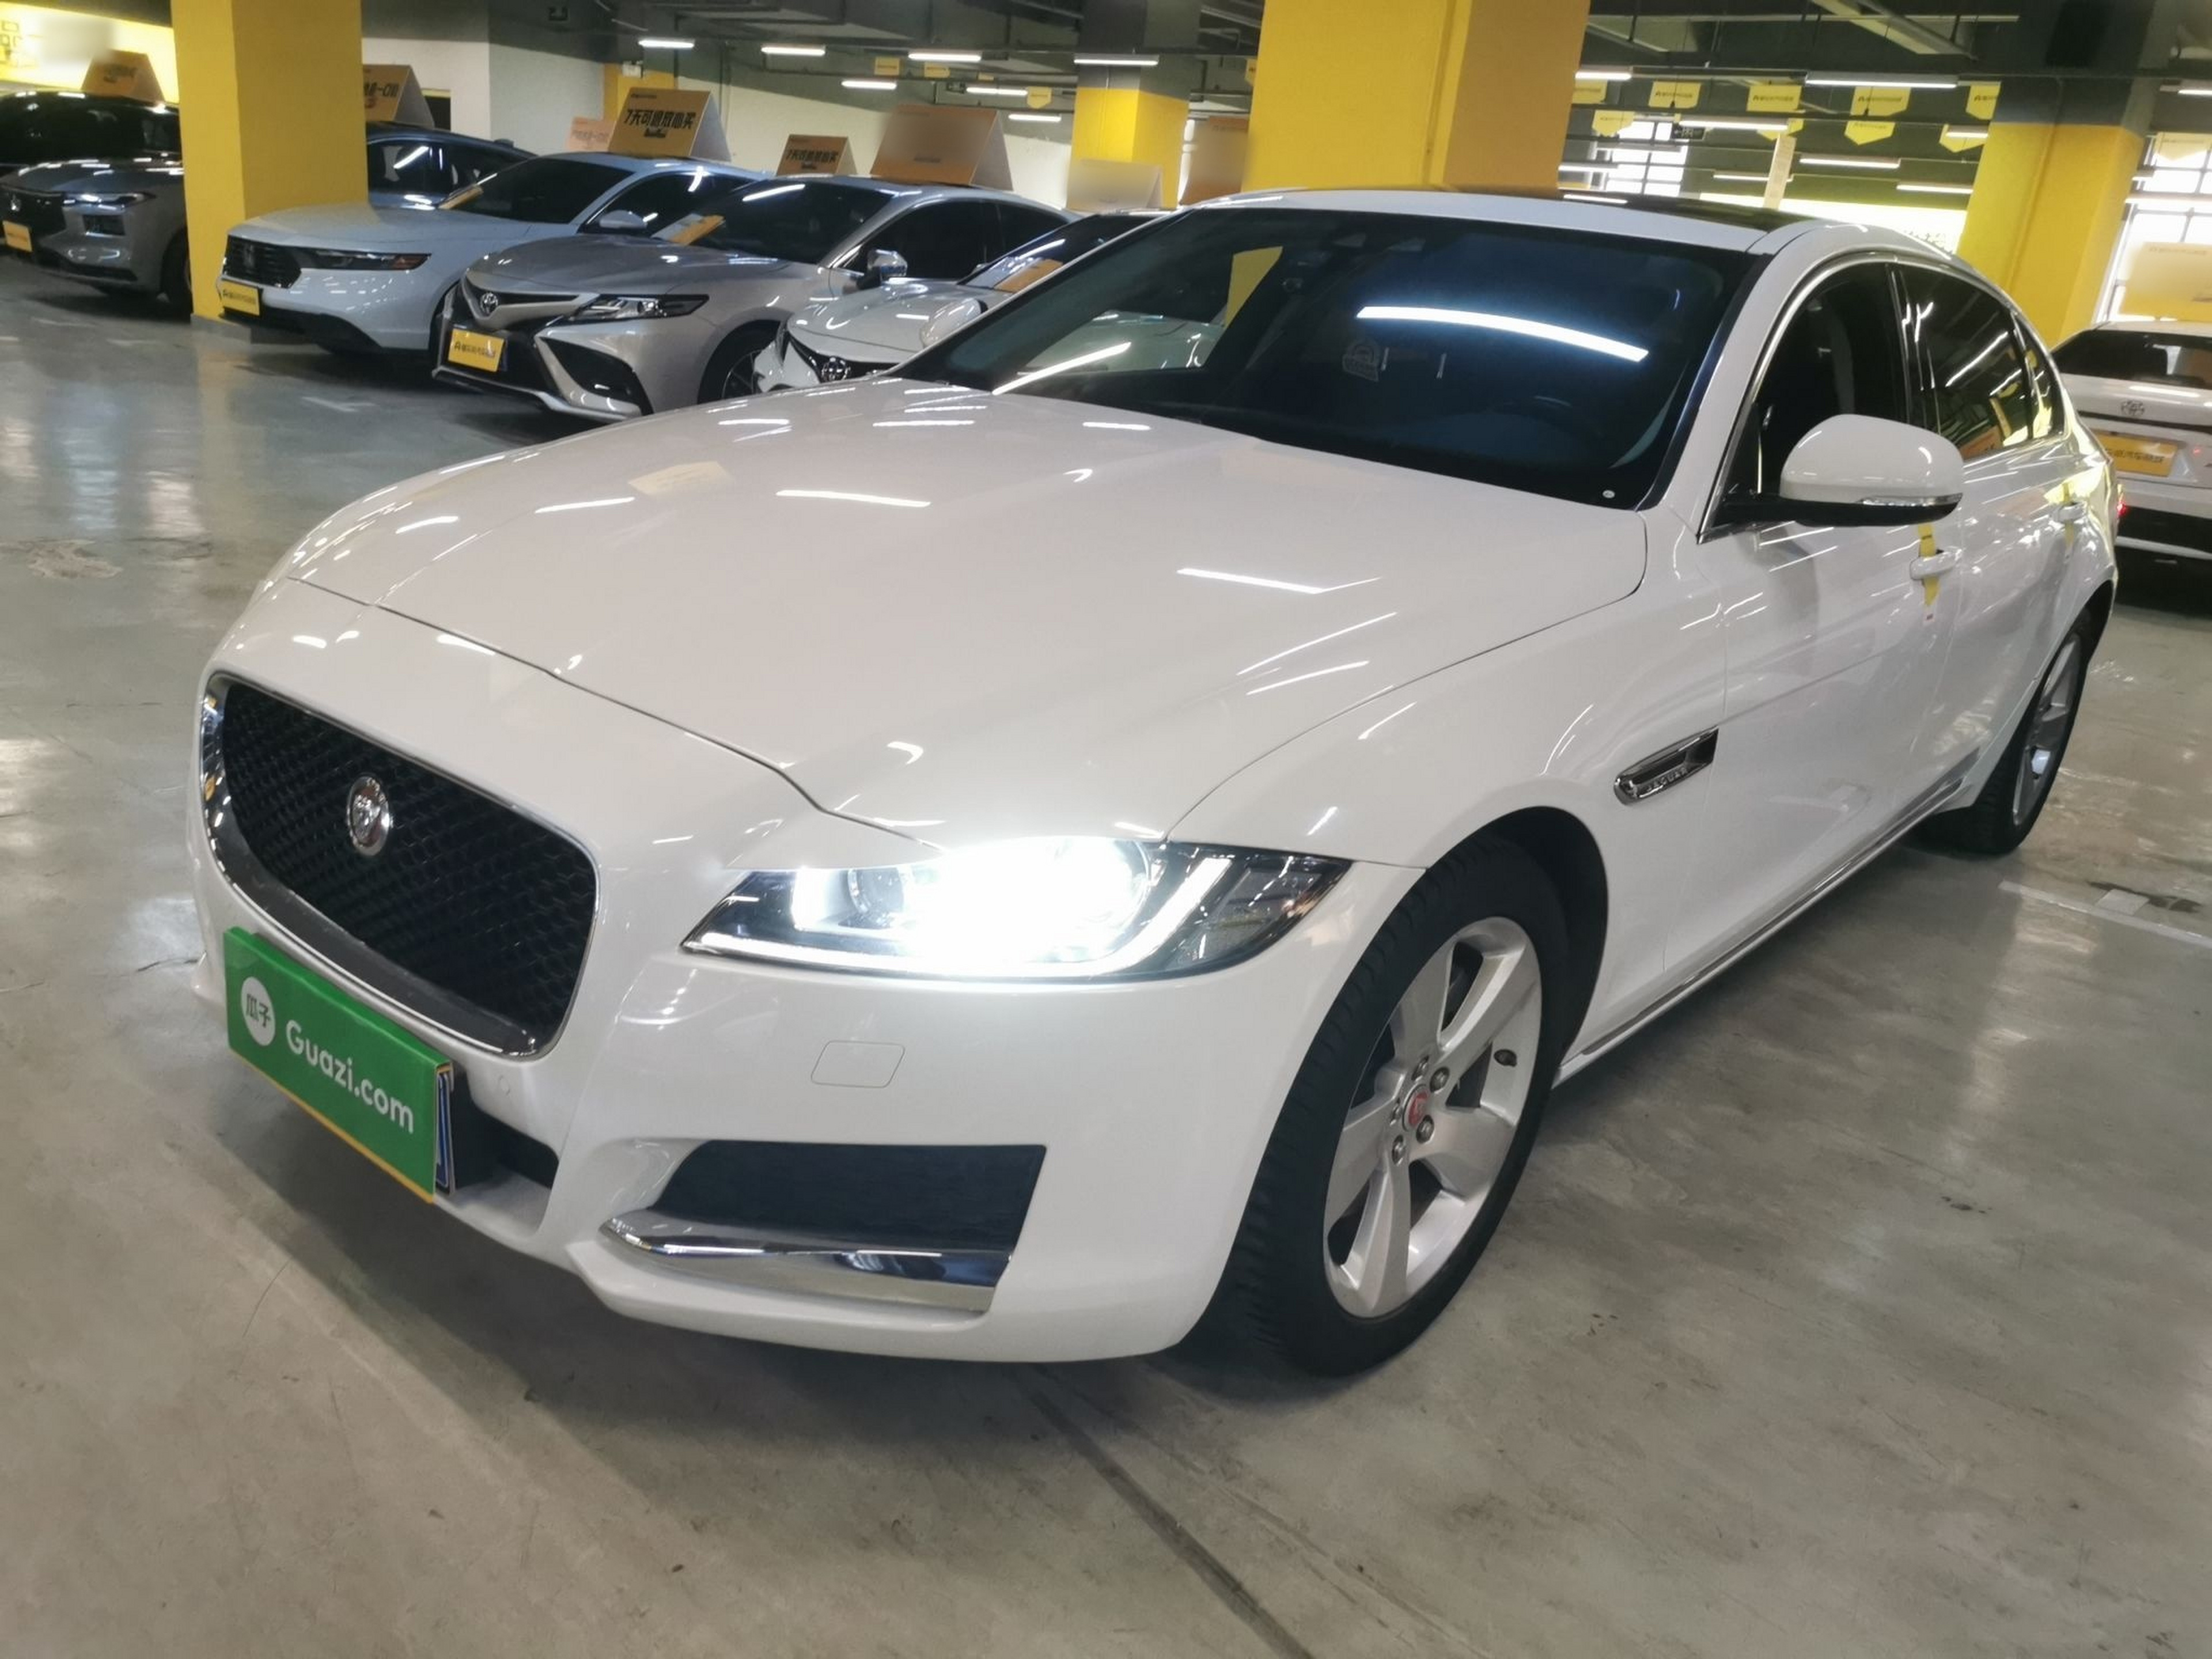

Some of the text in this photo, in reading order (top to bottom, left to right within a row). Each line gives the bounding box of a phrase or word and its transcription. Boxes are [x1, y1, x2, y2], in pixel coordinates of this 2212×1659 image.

[1647, 767, 1688, 791] JAGUAR
[246, 993, 271, 1028] 瓜子
[286, 1019, 414, 1134] Guazi.com
